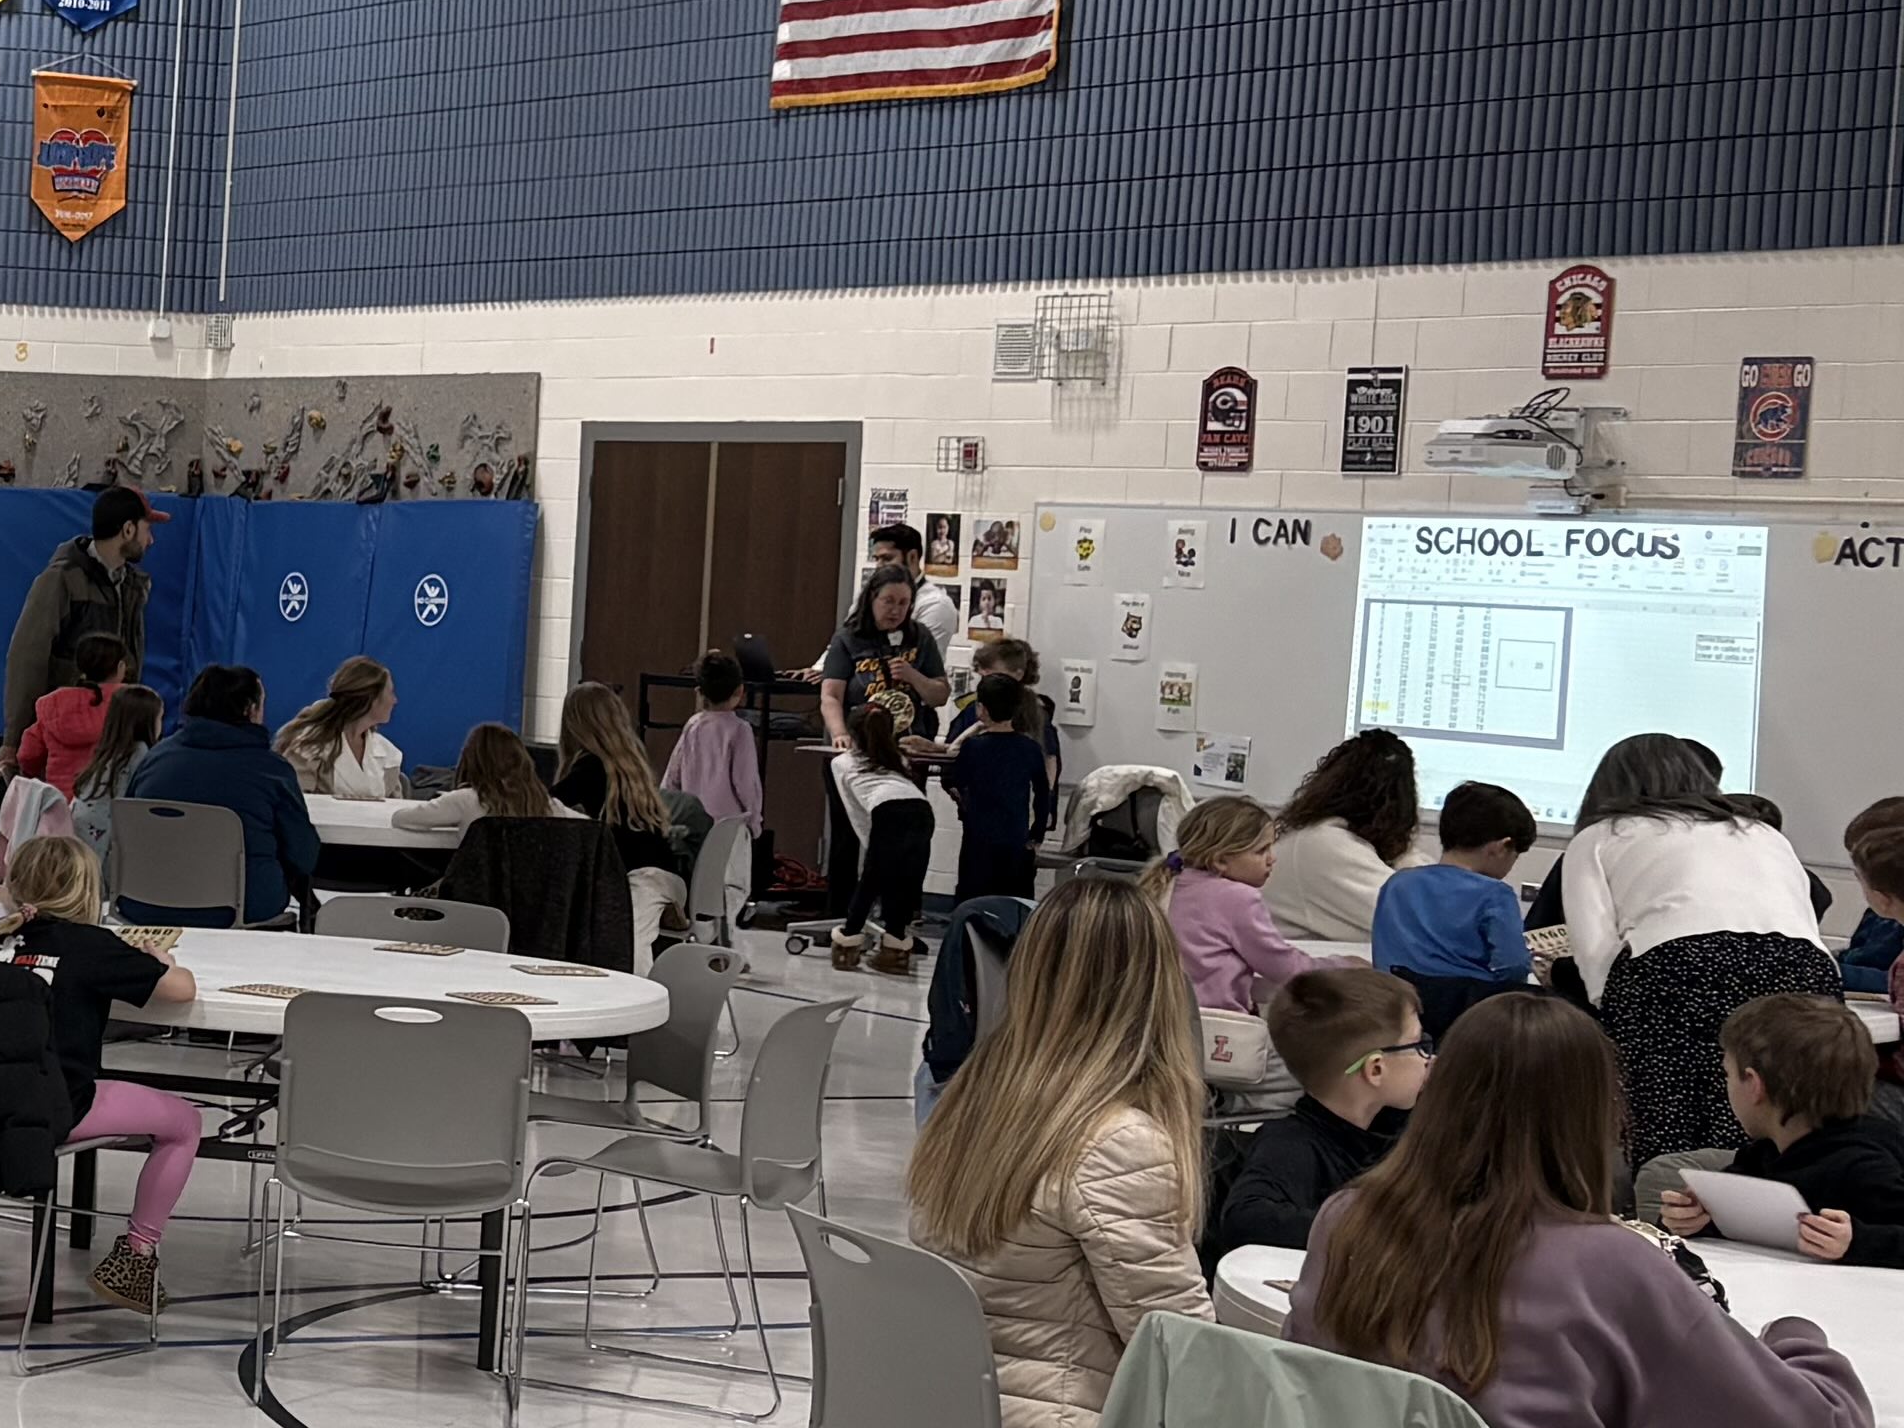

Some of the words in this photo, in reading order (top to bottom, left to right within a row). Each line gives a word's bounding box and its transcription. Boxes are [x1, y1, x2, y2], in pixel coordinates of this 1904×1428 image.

[1555, 274, 1607, 292] CHICAGO
[1548, 337, 1605, 348] BLACKHAWKS
[16, 342, 28, 362] 3
[1581, 353, 1604, 362] CLUB
[1742, 364, 1759, 387] GO
[1793, 364, 1811, 387] GO
[1350, 393, 1377, 404] WHITE
[1379, 393, 1397, 404] SOX
[1347, 416, 1394, 433] 1901
[1347, 437, 1369, 447] PLAY
[1229, 518, 1236, 544] I
[1252, 518, 1311, 546] CAN
[1415, 526, 1543, 557] SCHOOL
[1565, 528, 1680, 560] FOCUS
[121, 927, 174, 936] BINGO
[1211, 1035, 1233, 1063] L
